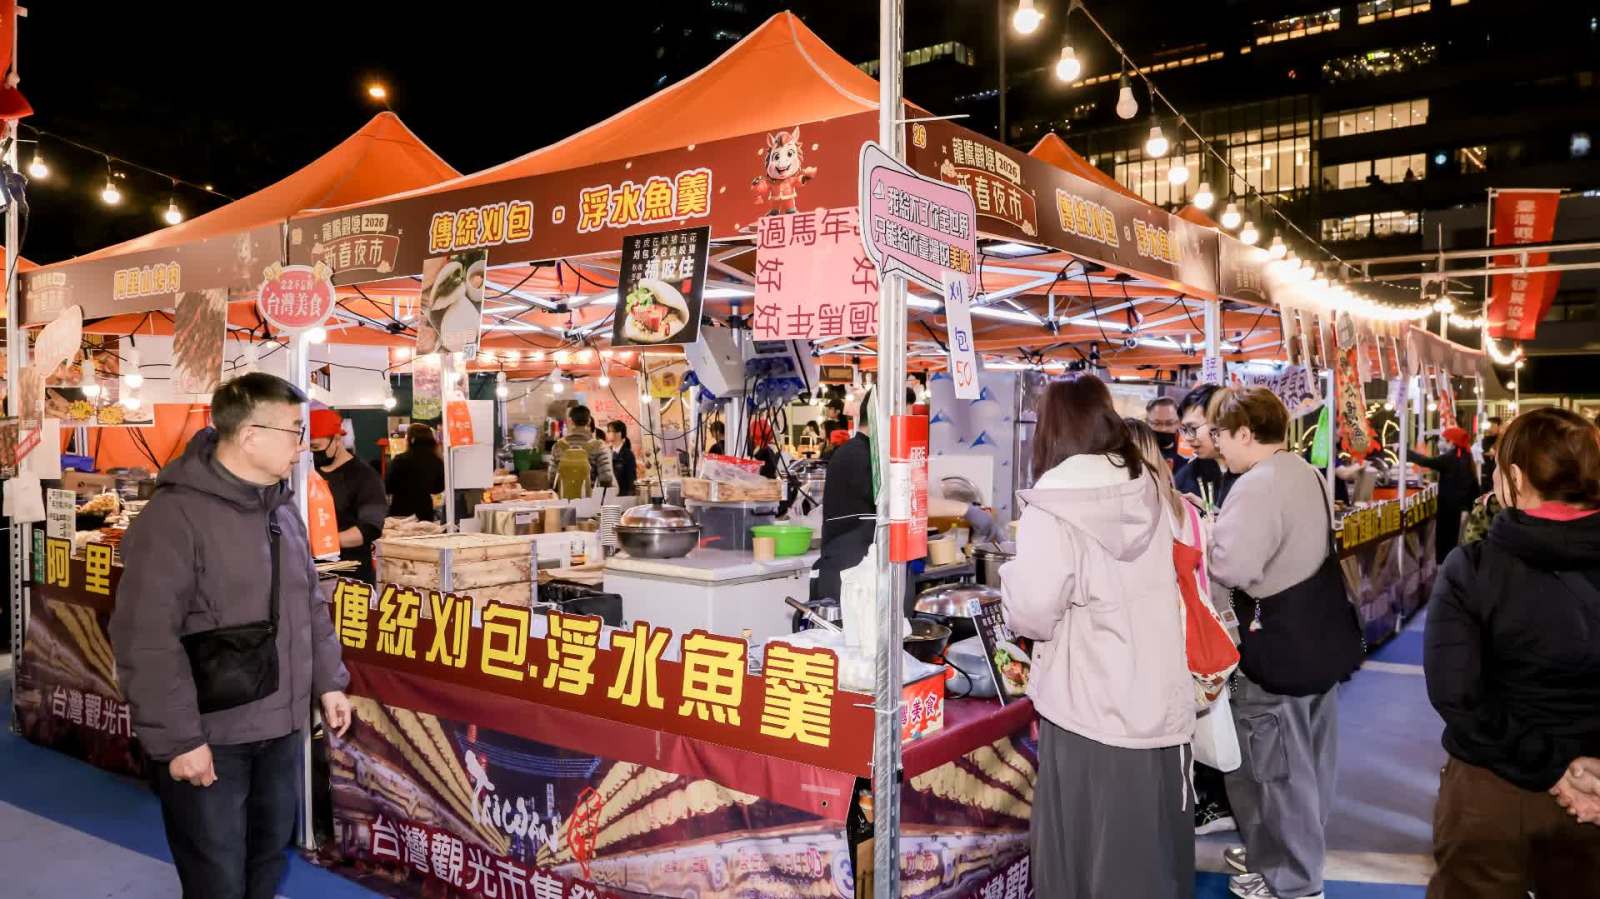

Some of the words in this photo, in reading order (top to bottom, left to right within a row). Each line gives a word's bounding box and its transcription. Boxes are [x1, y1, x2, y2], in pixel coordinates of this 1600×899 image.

[999, 158, 1017, 180] 2026
[365, 217, 385, 228] 2026
[431, 203, 531, 251] 傳統刈包
[579, 169, 712, 231] 浮水魚羹
[887, 186, 970, 240] 我給不了你全世界
[758, 207, 860, 250] 過馬年
[267, 292, 323, 317] 台灣美食
[956, 360, 972, 386] 50
[47, 540, 111, 596] 阿里
